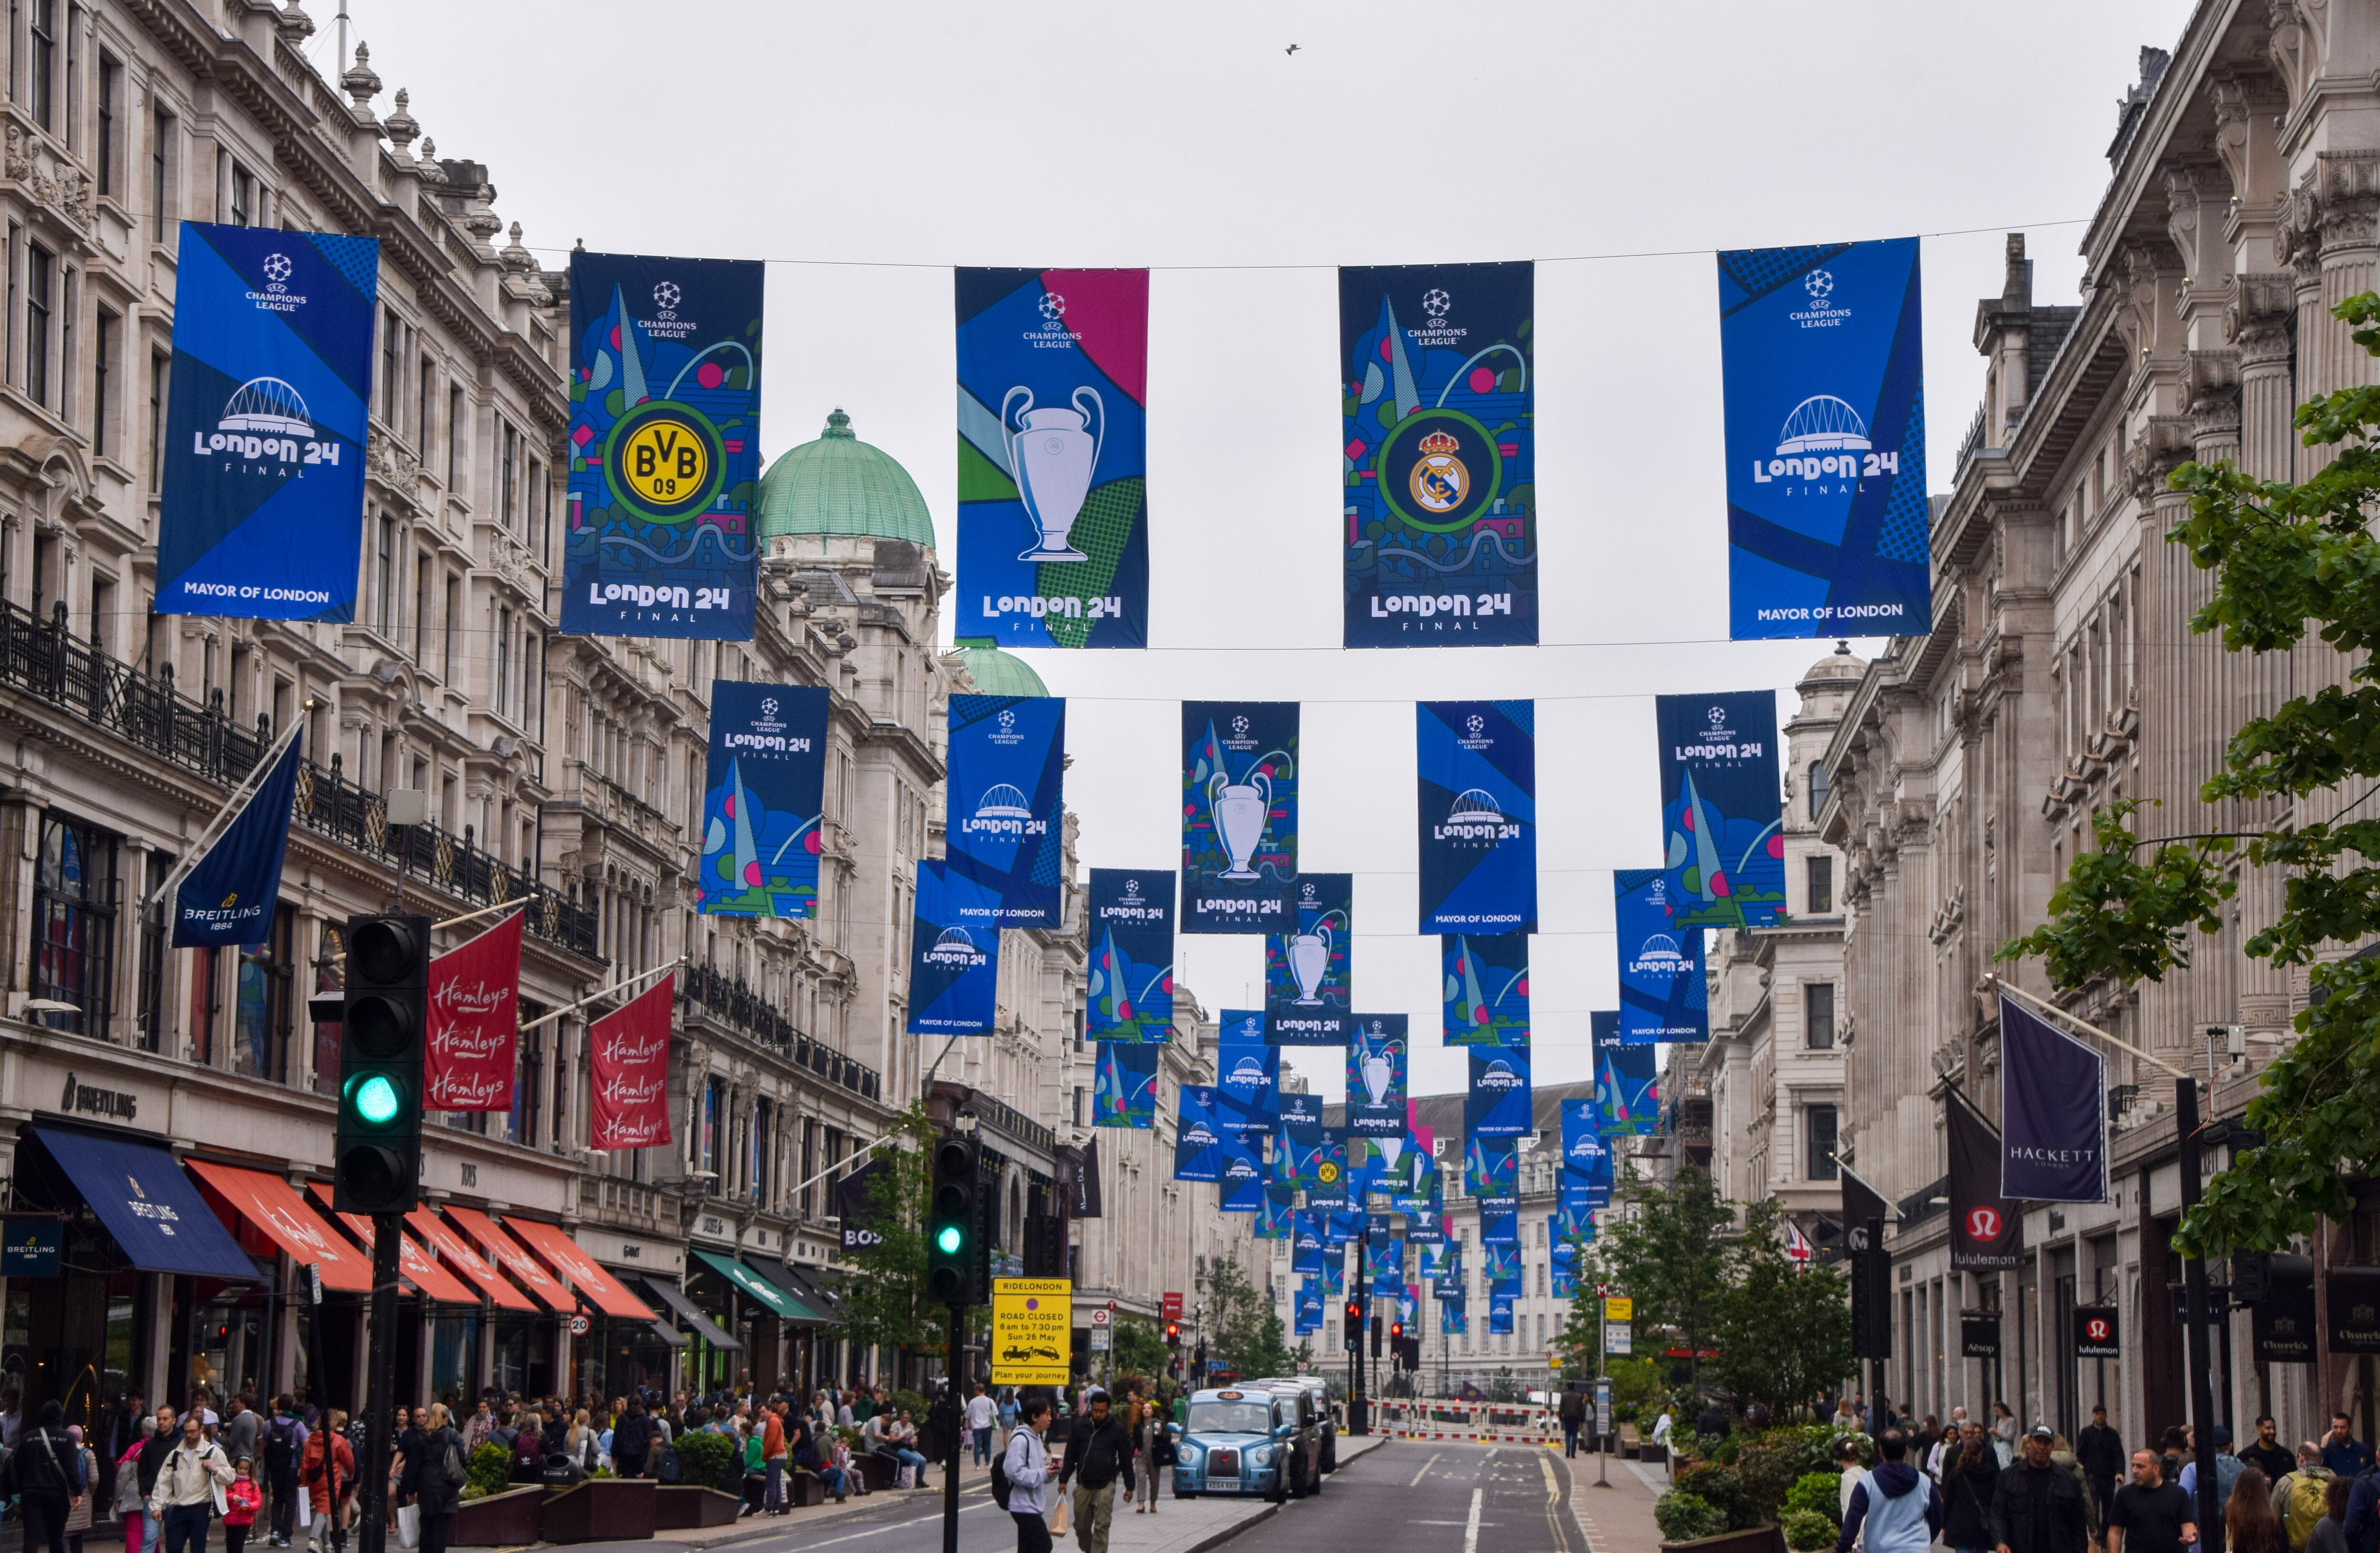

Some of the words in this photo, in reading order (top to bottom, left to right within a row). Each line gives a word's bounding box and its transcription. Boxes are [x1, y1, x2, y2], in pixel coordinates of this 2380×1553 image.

[267, 284, 286, 294] UEFA
[246, 292, 307, 304] CHAMPIONS
[256, 301, 296, 311] LEAGUE
[1810, 299, 1831, 309] UEFA
[657, 311, 677, 321] UEFA
[1790, 309, 1851, 320] CHAMPIONS
[638, 320, 696, 330] CHAMPIONS
[1427, 319, 1448, 328] UEFA
[1801, 319, 1841, 329] LEAGUE
[648, 329, 686, 338] LEAGUE
[1023, 332, 1082, 340] CHAMPIONS
[1408, 329, 1467, 337] CHAMPIONS
[1418, 337, 1457, 345] LEAGUE
[304, 442, 340, 466] 24
[636, 429, 697, 479] BVB
[1863, 451, 1898, 477] 24
[226, 463, 305, 478] FINAL
[653, 478, 676, 495] 09
[1787, 483, 1864, 497] FINAL
[184, 582, 237, 597] MAYOR
[240, 586, 262, 598] OF
[265, 587, 330, 603] LONDON
[695, 588, 729, 609] 24
[1477, 593, 1511, 615] 24
[1087, 596, 1121, 619] 24
[1758, 608, 1810, 621] MAYOR
[1813, 607, 1834, 619] OF
[1836, 603, 1903, 618] LONDON
[621, 611, 695, 622] FINAL
[1014, 623, 1089, 632] FINAL
[1403, 621, 1479, 631] FINAL
[789, 738, 810, 752] 24
[743, 752, 789, 761] FINAL
[1740, 744, 1762, 758] 24
[1025, 820, 1046, 835] 24
[1498, 824, 1519, 839] 24
[1260, 899, 1281, 913] 24
[185, 905, 260, 920] BREITLING
[992, 908, 1005, 916] OF
[1006, 909, 1044, 917] LONDON
[1148, 908, 1163, 920] 24
[1436, 915, 1467, 923] MAYOR
[1468, 915, 1481, 923] OF
[1482, 914, 1521, 923] LONDON
[211, 921, 233, 931] 1884
[970, 955, 986, 966] 24
[1677, 960, 1694, 971] 24
[434, 975, 509, 1013] Hamleys
[1323, 1021, 1339, 1031] 24
[431, 1021, 505, 1060] Hamleys
[602, 1033, 664, 1063] Hamleys
[429, 1066, 504, 1106] Hamleys
[1259, 1076, 1271, 1085] 24
[1513, 1079, 1523, 1087] 24
[602, 1072, 663, 1104] Hamleys
[76, 1085, 137, 1120] BREITLING
[602, 1112, 662, 1143] Hamleys
[1388, 1119, 1399, 1128] 24
[2011, 1146, 2094, 1162] HACKETT
[1321, 1165, 1335, 1176] BVB
[128, 1201, 179, 1221] BREITLING
[1954, 1252, 2016, 1266] lululemon
[1597, 1285, 1607, 1294] M
[1028, 1313, 1064, 1321] CLOSED
[573, 1320, 587, 1329] 20
[1040, 1334, 1056, 1342] May
[2079, 1345, 2118, 1354] lululemon
[2263, 1340, 2308, 1350] Church's
